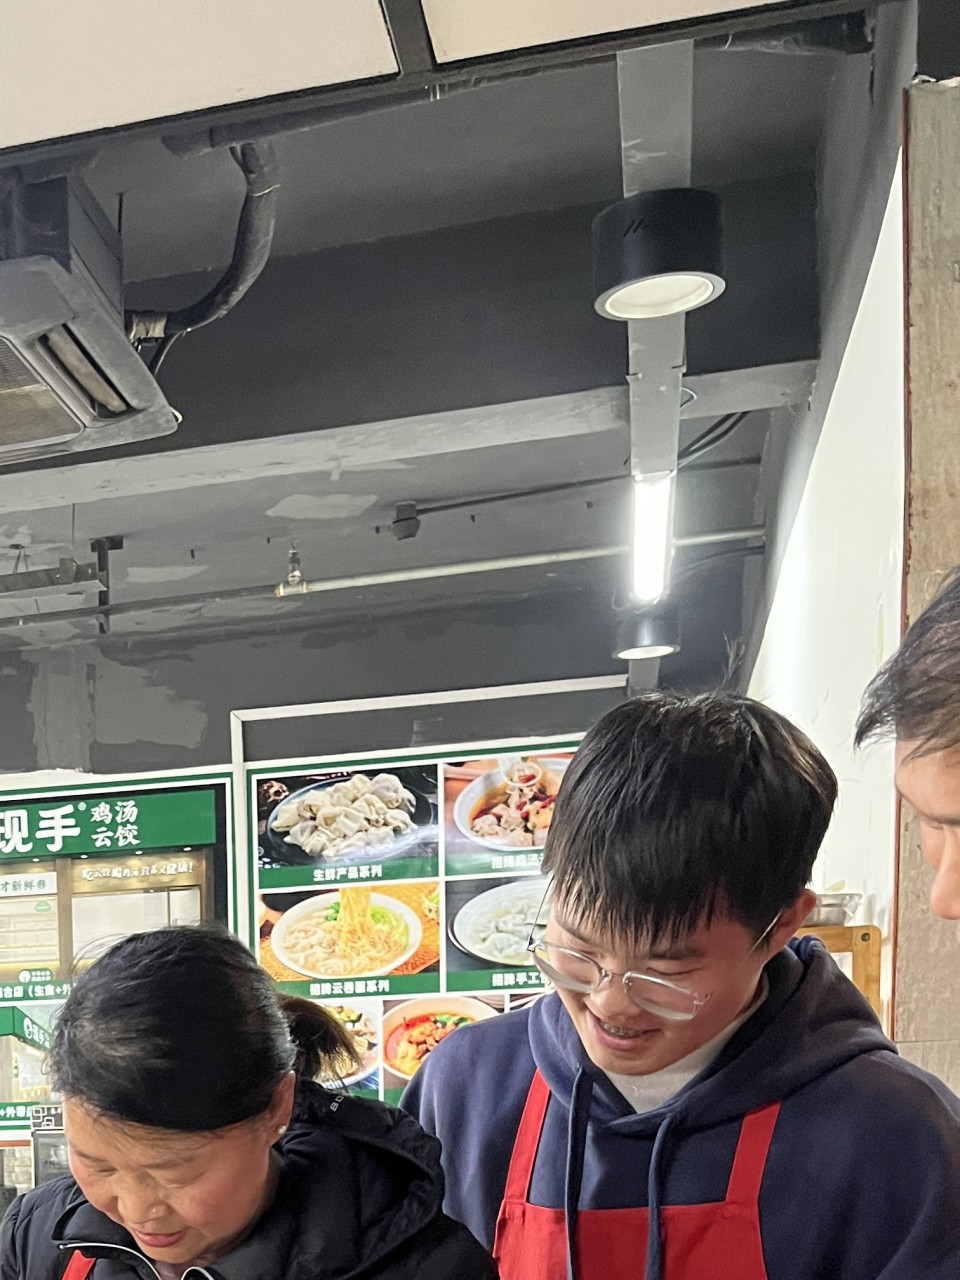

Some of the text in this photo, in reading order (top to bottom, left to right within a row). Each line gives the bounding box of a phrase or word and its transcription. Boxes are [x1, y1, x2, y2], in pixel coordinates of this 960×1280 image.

[90, 800, 138, 824] 鸡汤
[90, 824, 141, 847] 云饺
[313, 864, 383, 882] 生鲜产品系列
